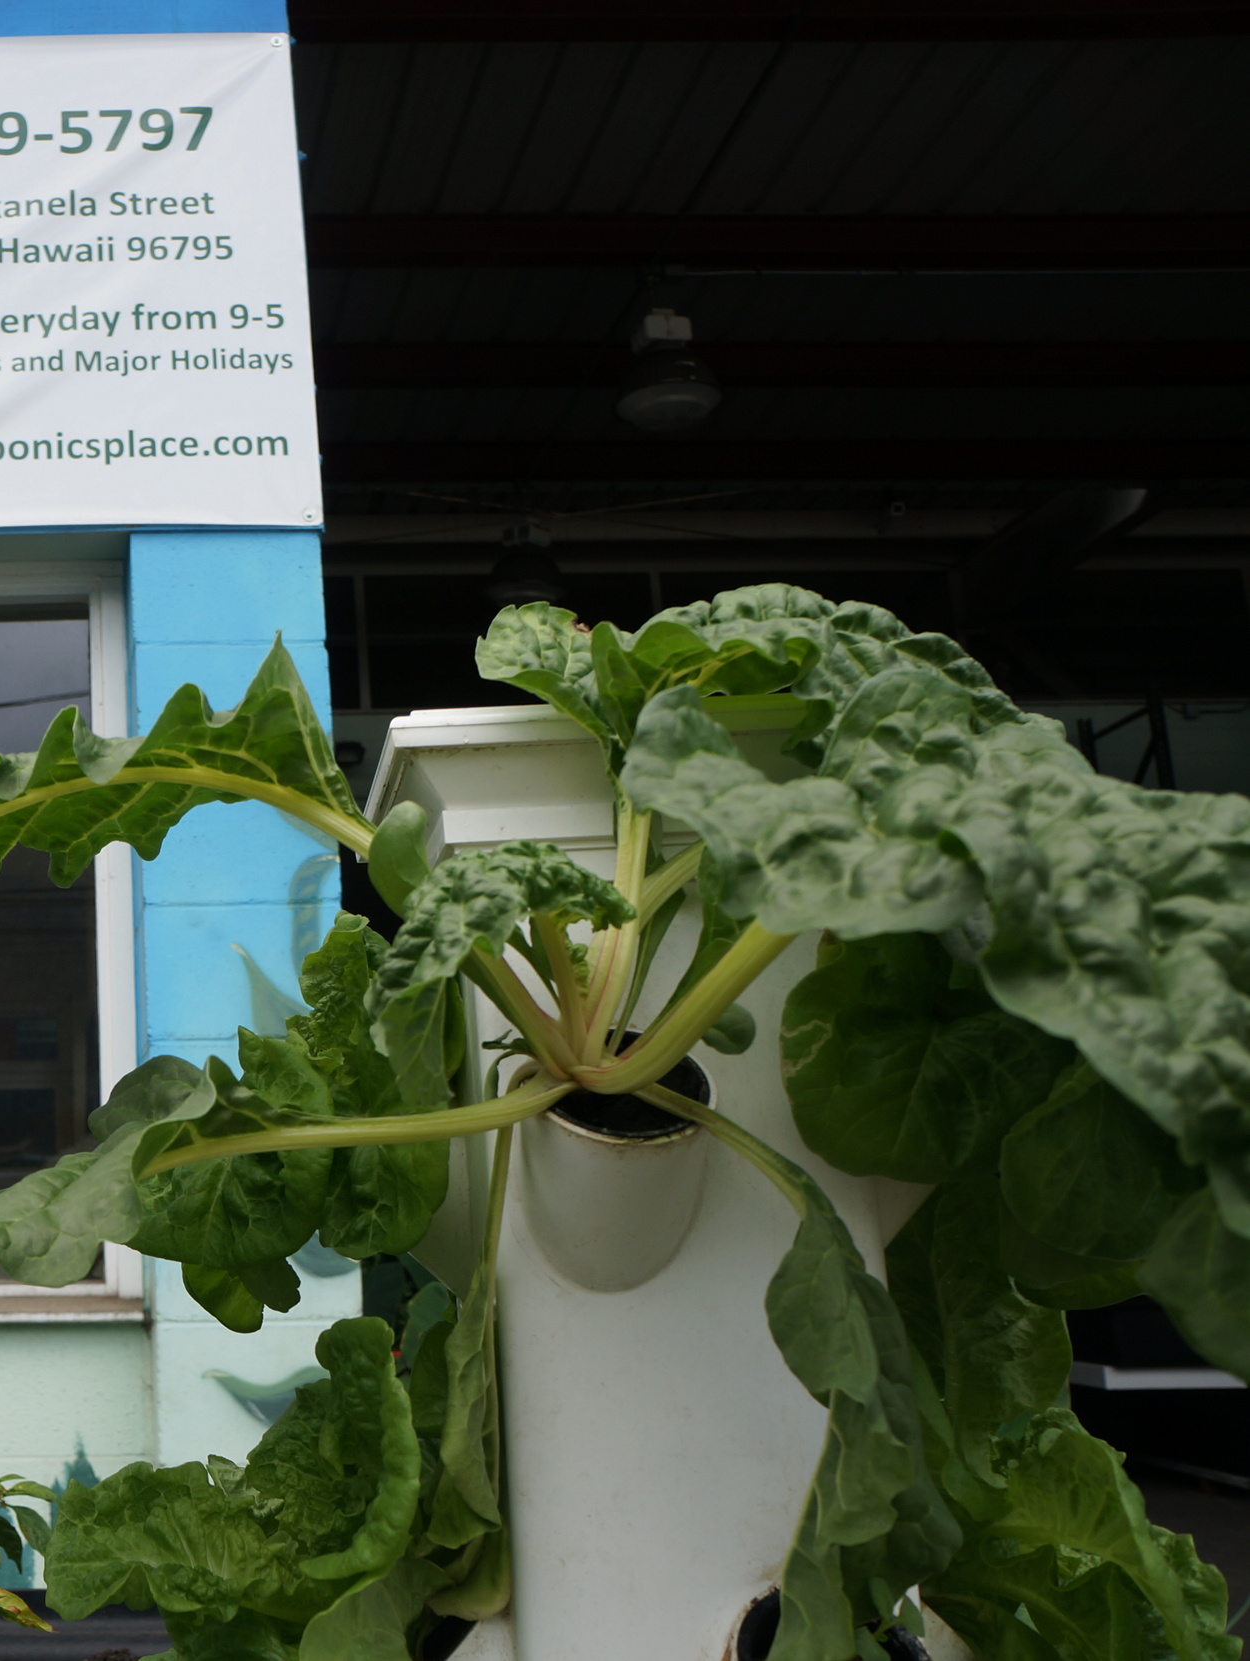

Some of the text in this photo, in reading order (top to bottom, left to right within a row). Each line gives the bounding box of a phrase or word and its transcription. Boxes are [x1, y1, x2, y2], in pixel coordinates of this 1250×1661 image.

[110, 192, 215, 215] Street
[127, 235, 233, 261] 96795
[131, 303, 216, 330] from
[230, 304, 284, 329] 9-5
[12, 349, 63, 371] and
[76, 350, 161, 376] Major
[171, 348, 293, 374] Holidays
